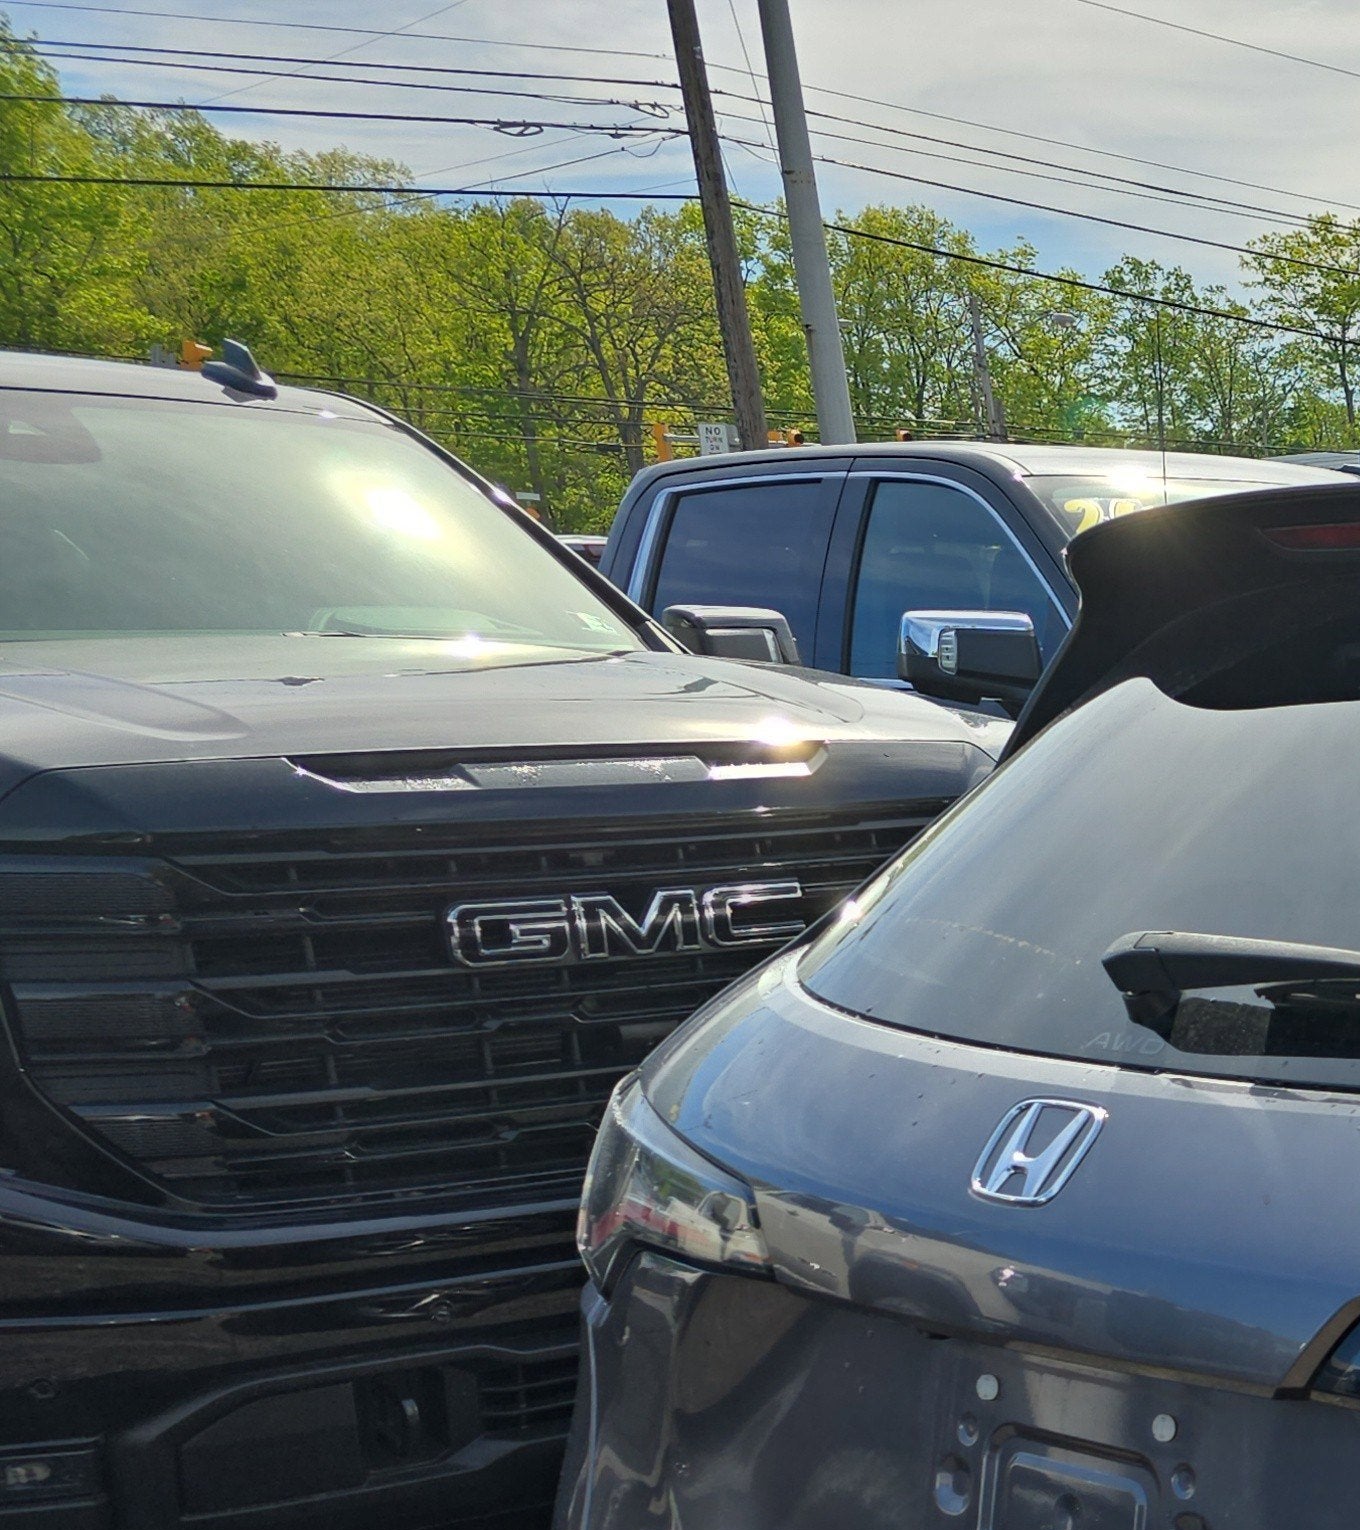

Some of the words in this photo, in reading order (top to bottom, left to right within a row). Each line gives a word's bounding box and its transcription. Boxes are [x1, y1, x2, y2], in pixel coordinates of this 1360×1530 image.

[705, 426, 721, 435] NO
[448, 878, 806, 968] GMC
[1080, 1032, 1165, 1055] AWD
